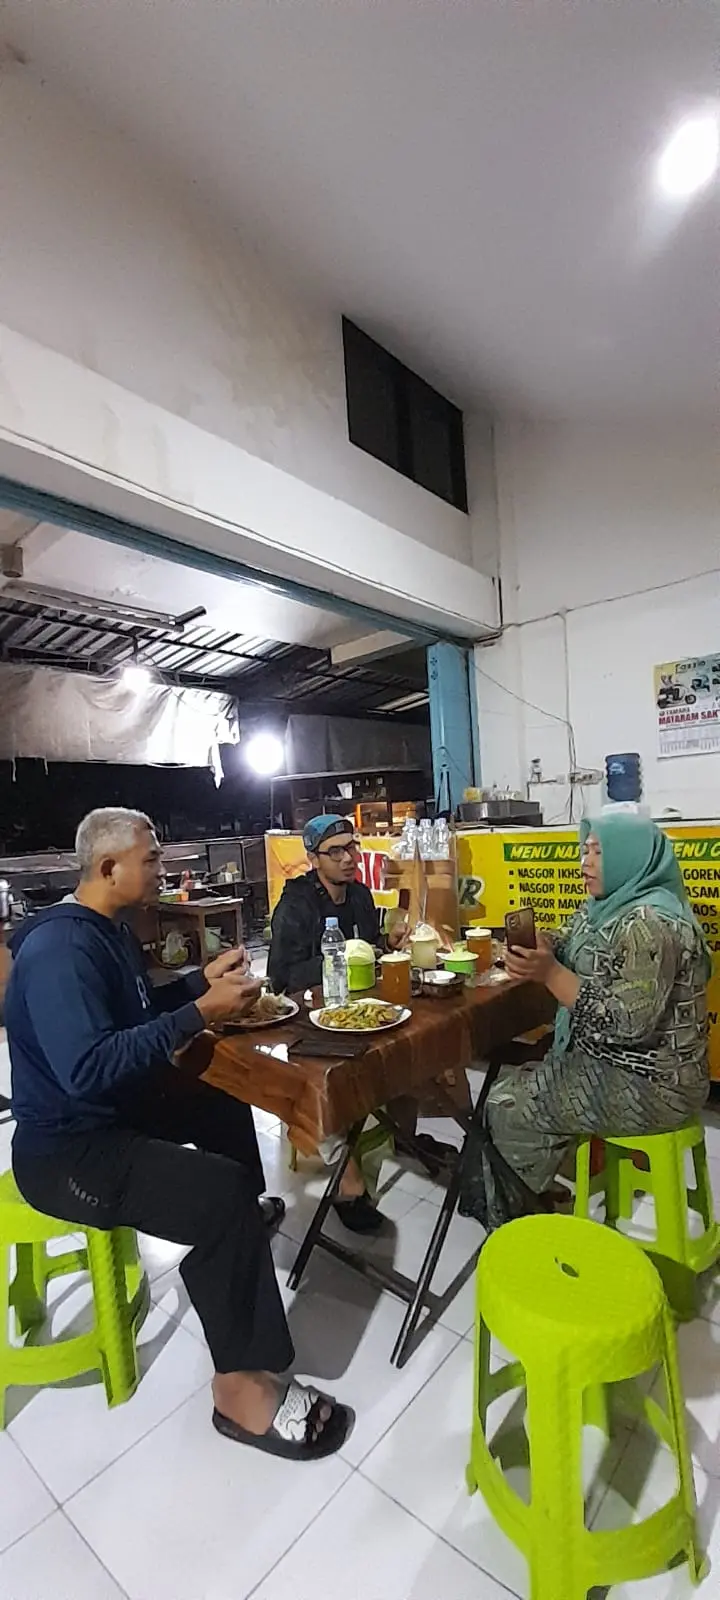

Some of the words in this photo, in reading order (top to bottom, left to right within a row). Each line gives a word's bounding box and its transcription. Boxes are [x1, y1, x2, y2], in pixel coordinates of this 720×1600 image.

[659, 712, 699, 725] MATARAM
[510, 845, 552, 859] MENU
[673, 841, 708, 857] ENU
[517, 867, 555, 879] NASGOR
[519, 882, 555, 894] NASGOR
[519, 896, 555, 908] NASGOR
